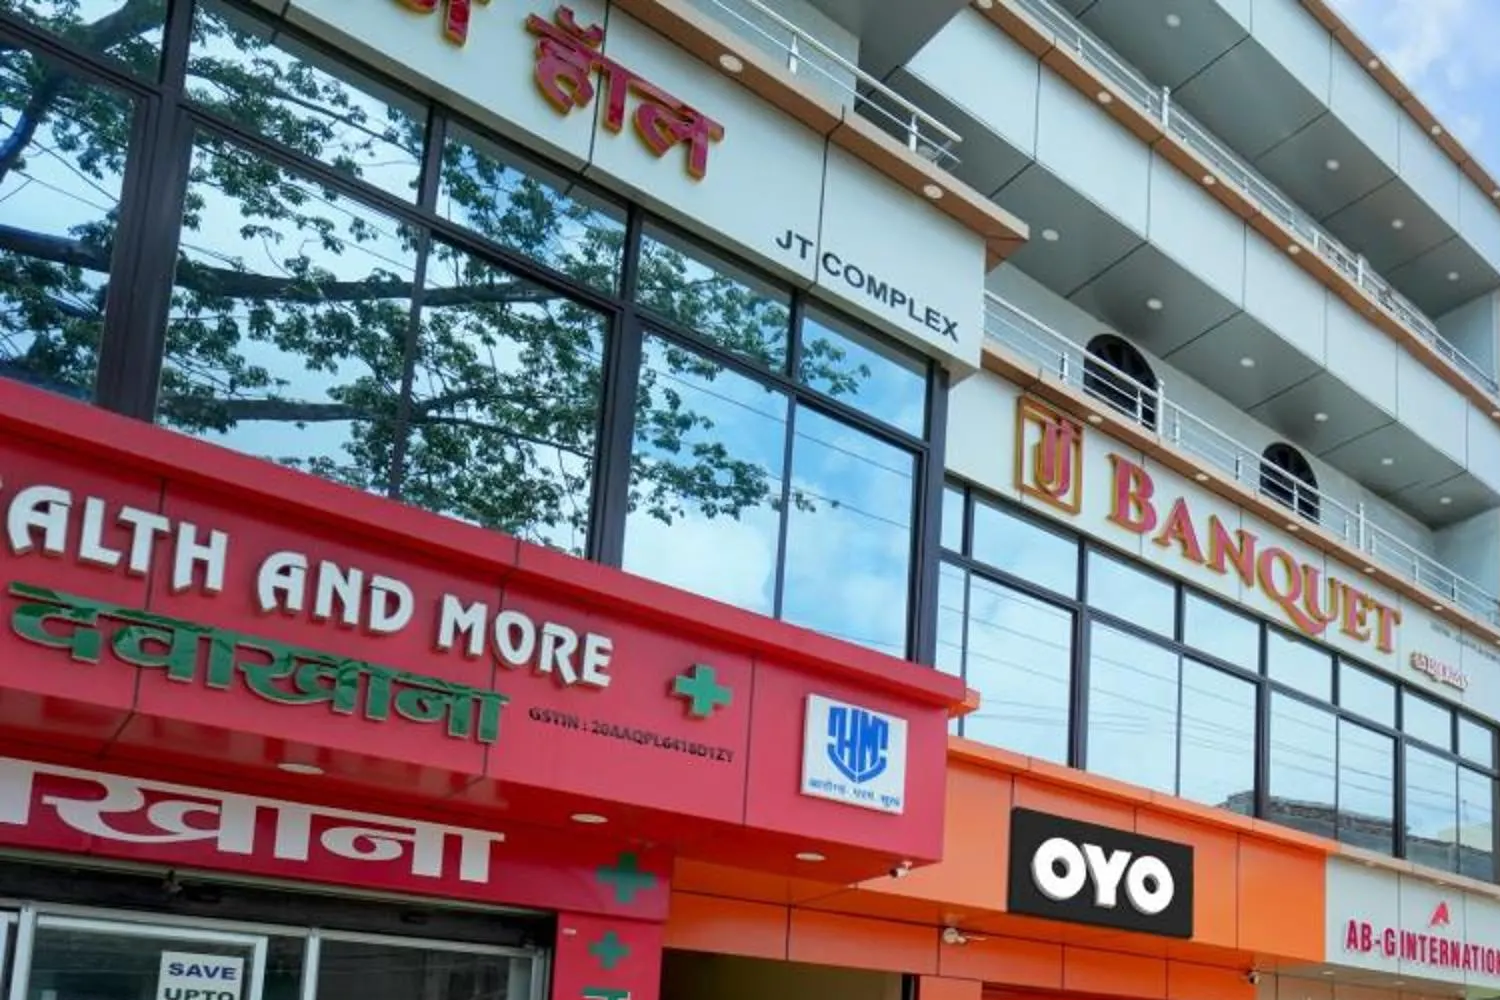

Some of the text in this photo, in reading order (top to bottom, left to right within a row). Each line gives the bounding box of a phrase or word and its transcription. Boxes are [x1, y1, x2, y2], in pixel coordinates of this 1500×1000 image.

[525, 5, 725, 181] हॉल
[776, 230, 960, 344] JT COMPLEX
[0, 473, 613, 689] ALTH AND MORE
[1107, 452, 1401, 656] BANQUET
[8, 582, 509, 744] दवाखाना
[528, 707, 579, 731] GSTIN
[1031, 837, 1175, 915] OYO
[168, 962, 238, 981] SAVE
[1346, 920, 1395, 957] AB-G
